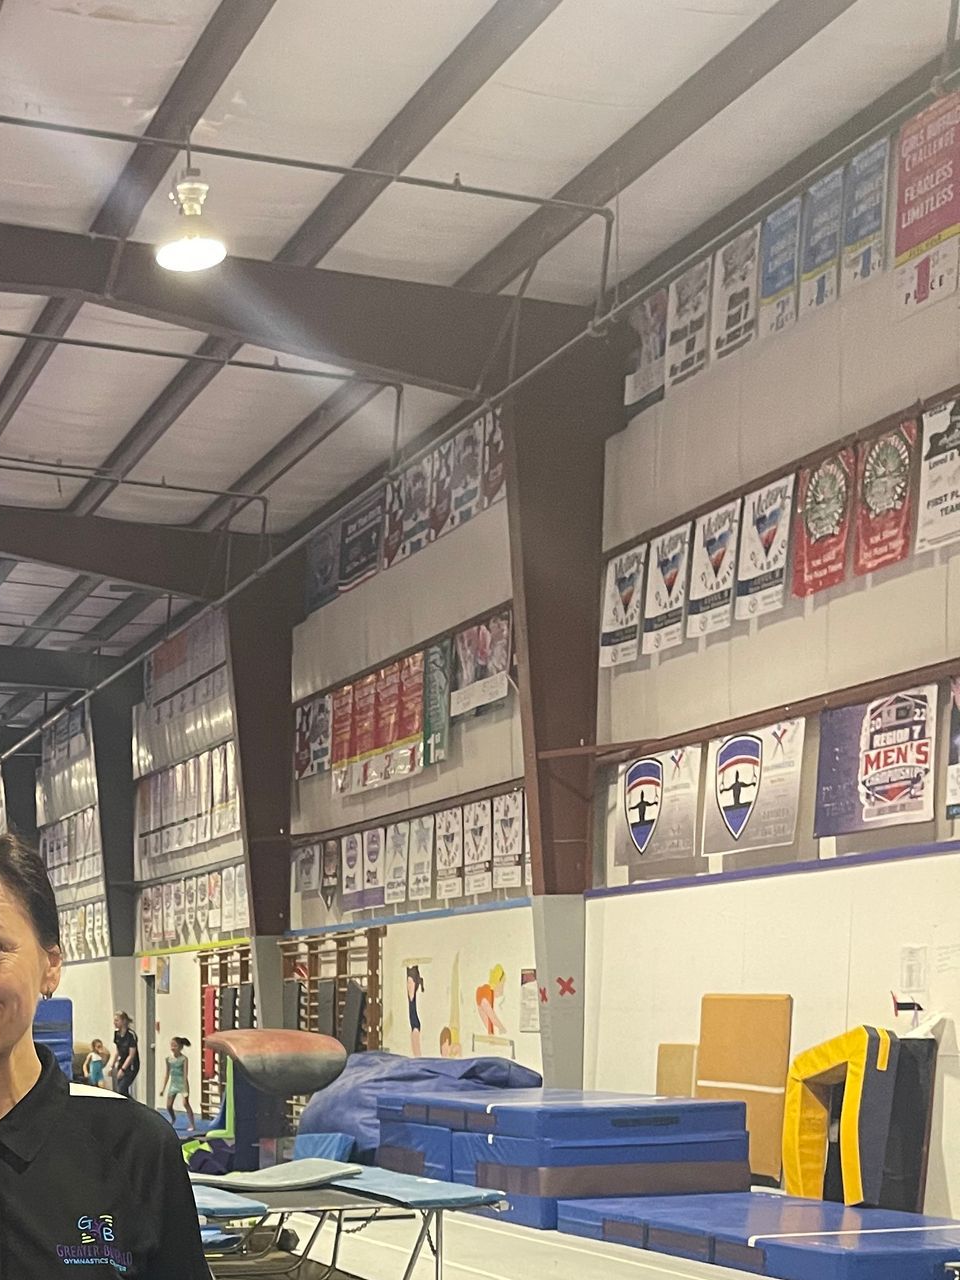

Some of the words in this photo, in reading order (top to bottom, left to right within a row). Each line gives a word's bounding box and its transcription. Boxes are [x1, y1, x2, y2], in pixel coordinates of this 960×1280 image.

[904, 160, 954, 205] FEARLESS
[901, 183, 954, 229] LIMITLESS
[913, 708, 927, 721] 22
[873, 727, 910, 749] REGION
[911, 724, 922, 739] 7
[864, 741, 929, 776] MEN'S
[56, 1244, 100, 1258] GREATER
